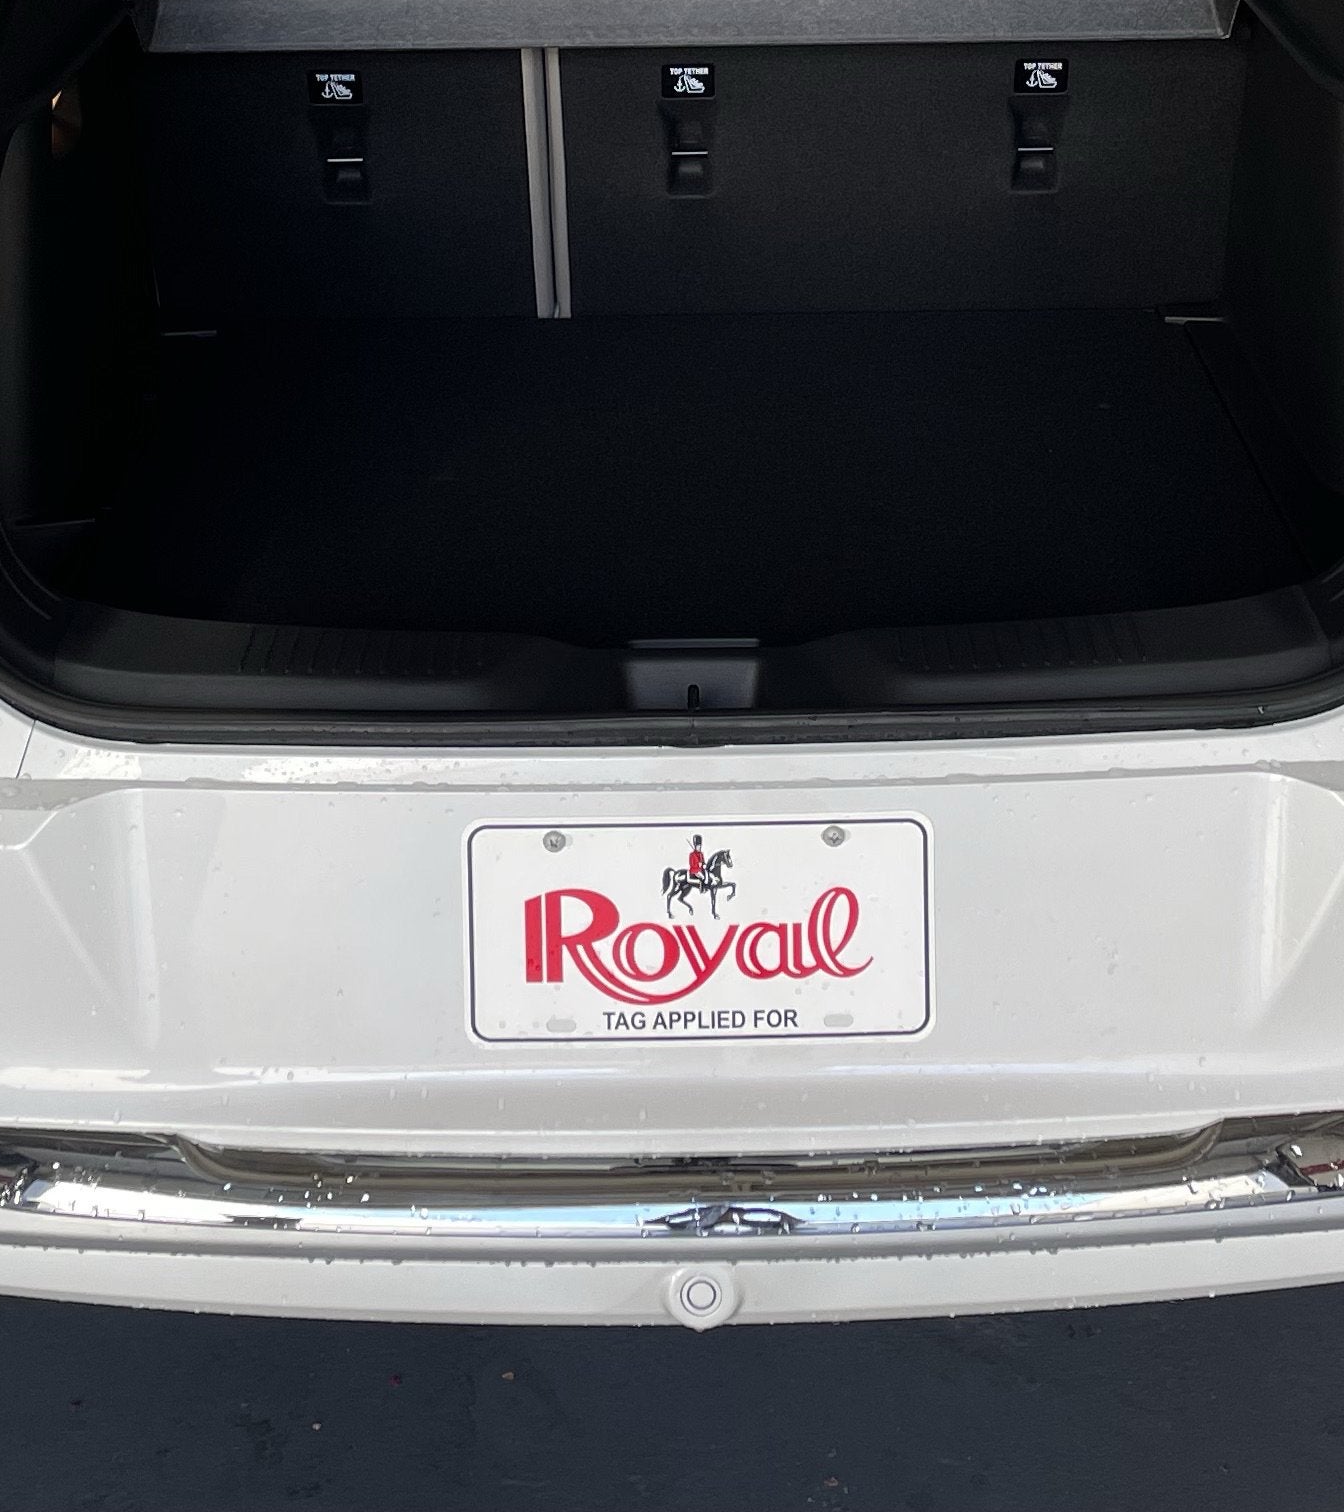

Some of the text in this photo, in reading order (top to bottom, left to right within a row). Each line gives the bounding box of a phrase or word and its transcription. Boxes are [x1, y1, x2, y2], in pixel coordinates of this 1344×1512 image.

[669, 67, 683, 75] TOP
[1023, 62, 1037, 70] TOP
[523, 886, 875, 1006] Royal
[602, 1008, 800, 1031] TAG APPLIED FOR
